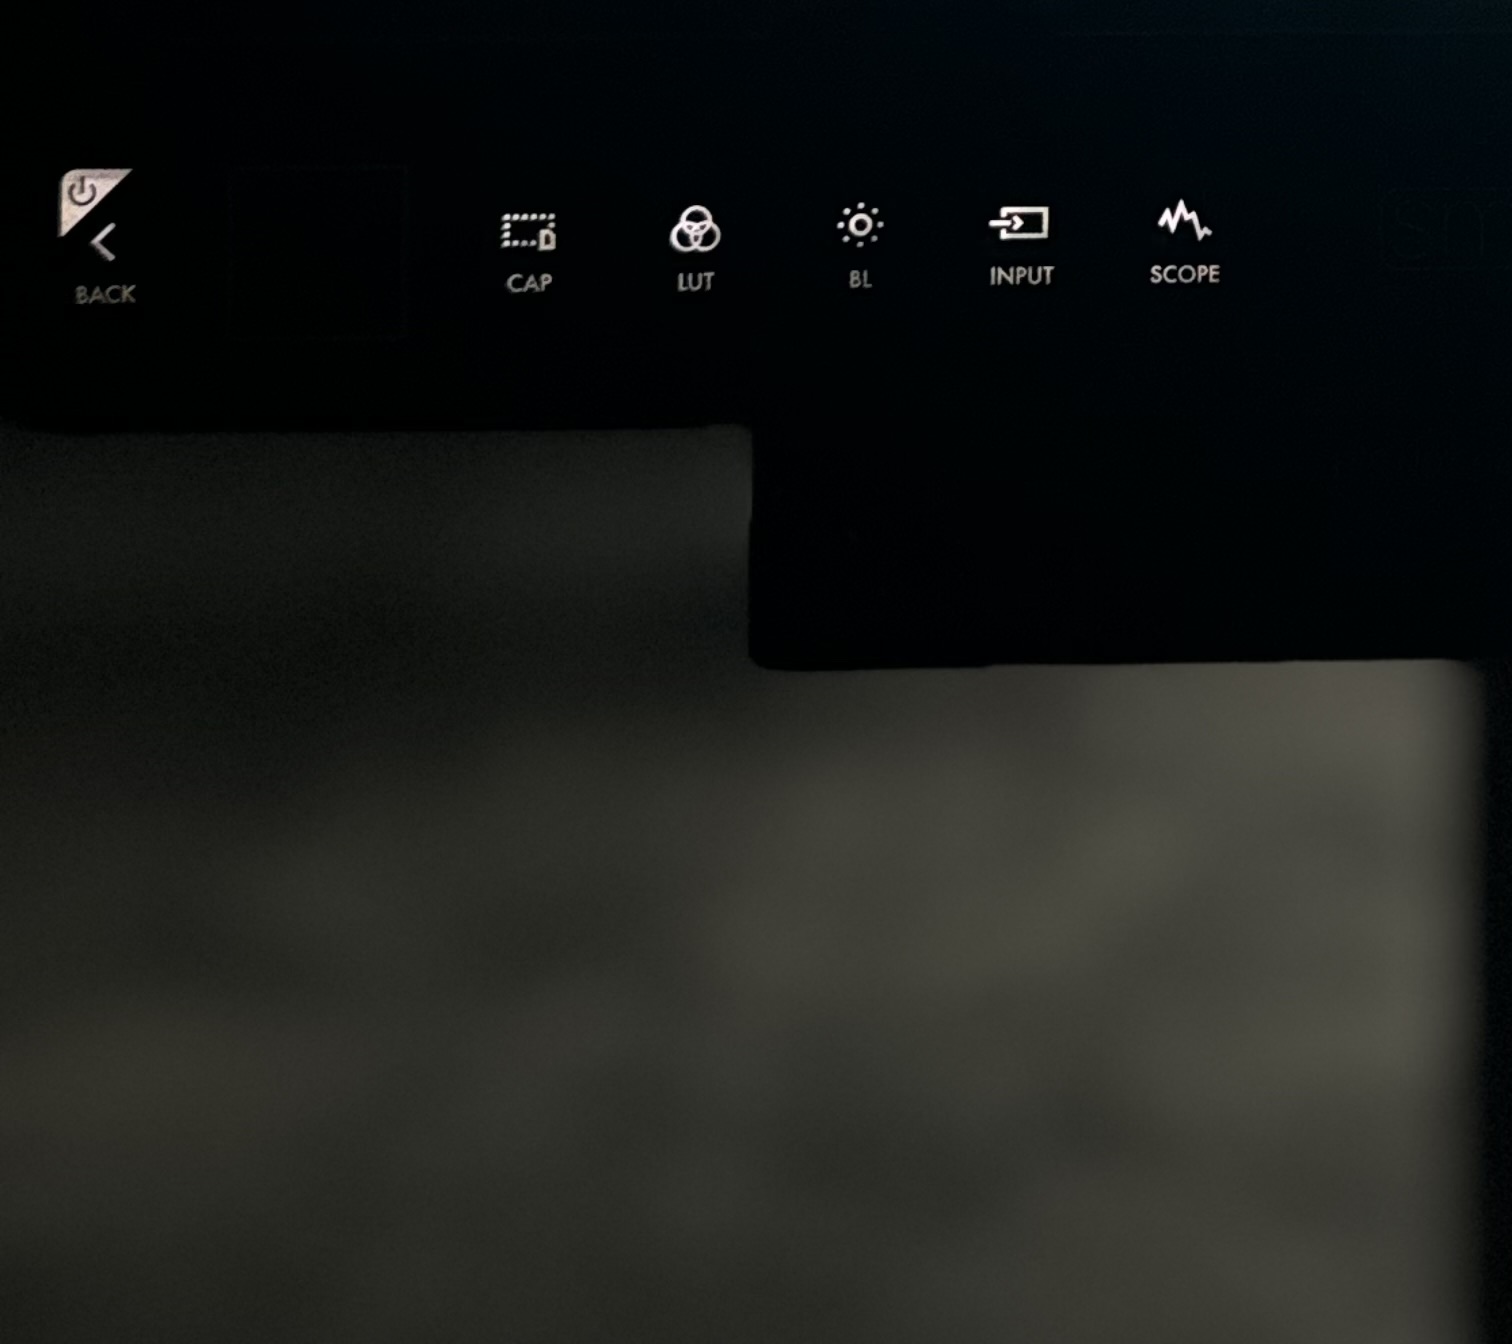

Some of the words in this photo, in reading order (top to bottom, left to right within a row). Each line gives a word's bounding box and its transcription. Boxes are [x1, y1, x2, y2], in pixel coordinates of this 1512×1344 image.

[506, 273, 553, 293] CAP
[677, 271, 715, 291] LUT
[849, 269, 873, 289] BL
[989, 265, 1055, 286] INPUT
[1150, 264, 1221, 285] SCOPE
[74, 284, 136, 305] BACK
